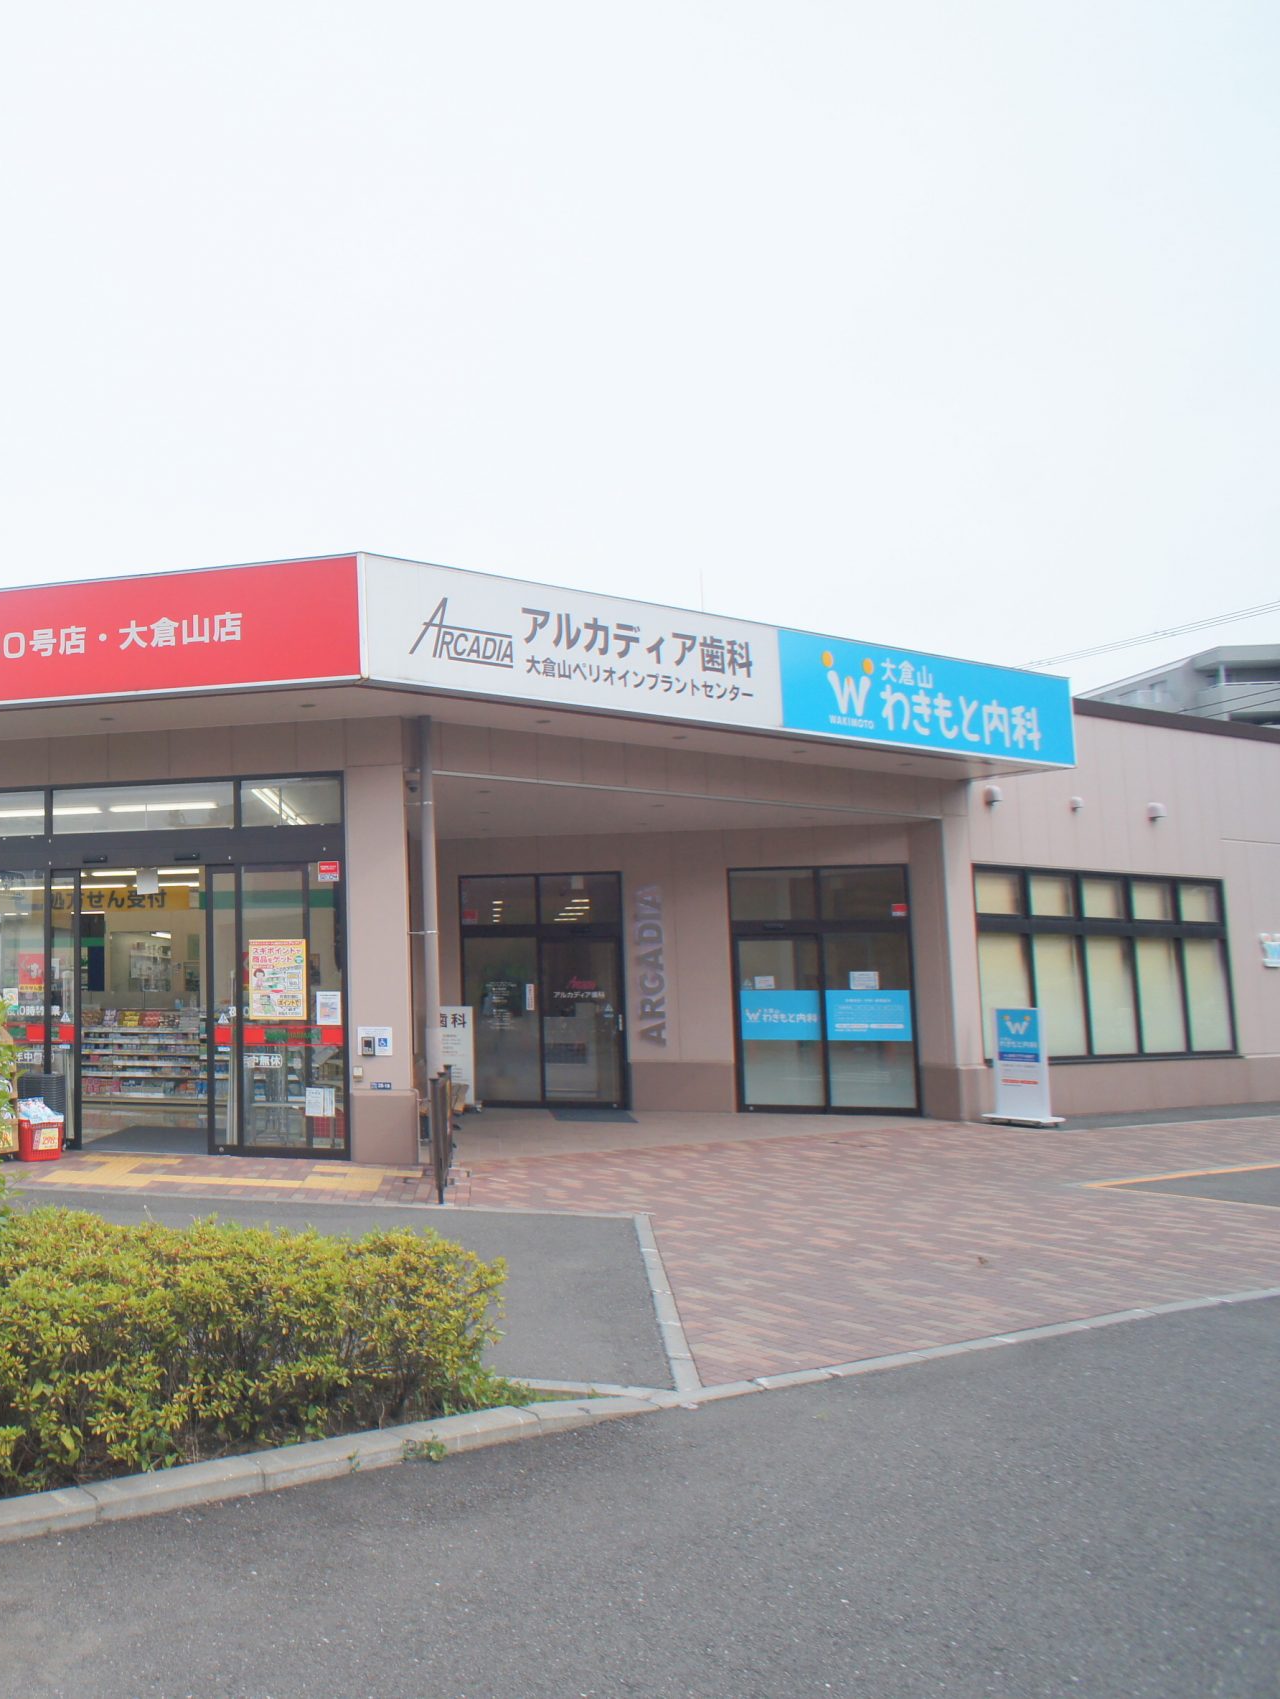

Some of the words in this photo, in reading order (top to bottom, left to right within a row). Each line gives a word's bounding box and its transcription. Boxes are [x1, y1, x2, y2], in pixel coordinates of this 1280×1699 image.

[409, 597, 514, 669] ARCADIA
[521, 607, 753, 679] アルカディア歯科
[526, 655, 754, 702] 大倉山ペリオインプラントセンター
[880, 657, 934, 689] 大倉山
[829, 714, 875, 730] WAKIMOTO
[879, 684, 1042, 751] わきもと内科
